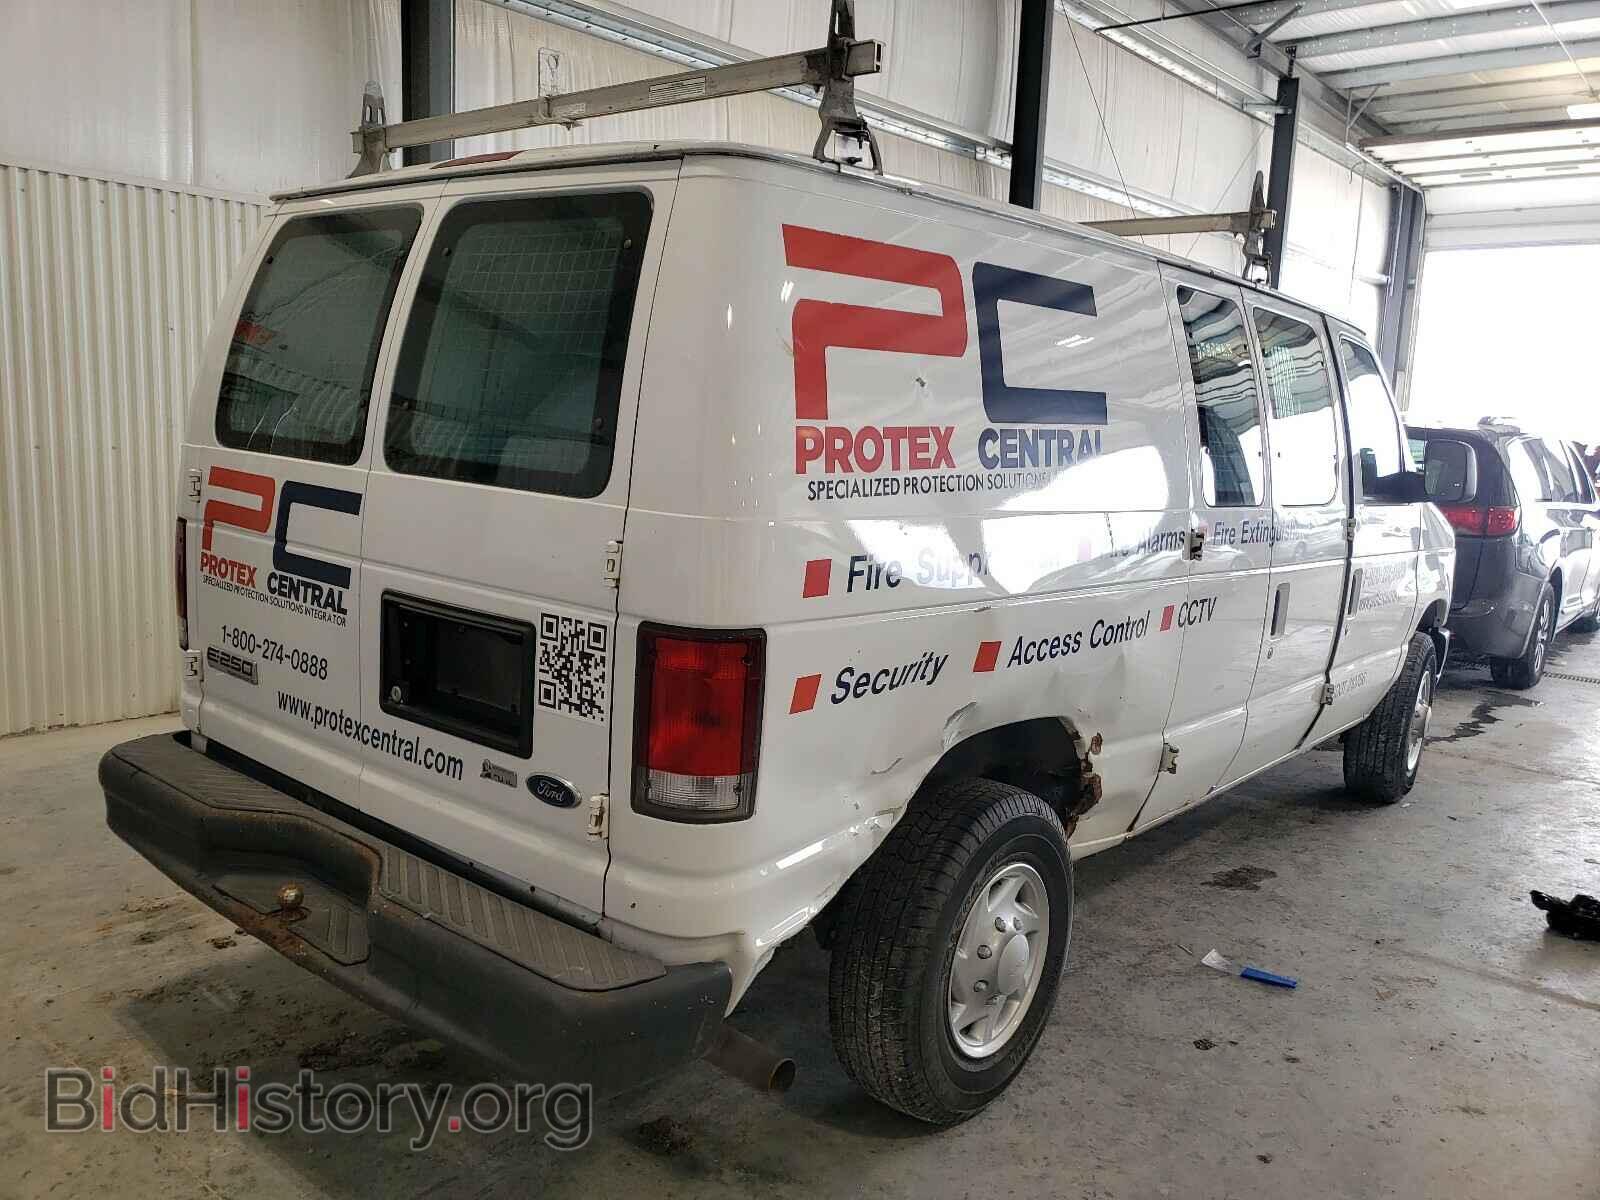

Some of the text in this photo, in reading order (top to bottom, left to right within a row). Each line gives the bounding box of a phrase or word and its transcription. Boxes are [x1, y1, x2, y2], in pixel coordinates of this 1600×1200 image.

[795, 425, 956, 474] PROTEX
[807, 476, 900, 501] SPECIALIZED
[903, 474, 984, 494] PROTECTION
[200, 552, 348, 615] PROTEX CENTRAL
[846, 554, 902, 593] Fire
[1213, 521, 1236, 545] Fire
[202, 574, 347, 628] SPECIALIZED PROTECTION SOLUTIONS INTEGRATOR
[221, 624, 329, 681] 1-800-274-0888
[830, 597, 1218, 705] Security Access Control CCTV
[277, 690, 464, 781] www.protexcentral.com
